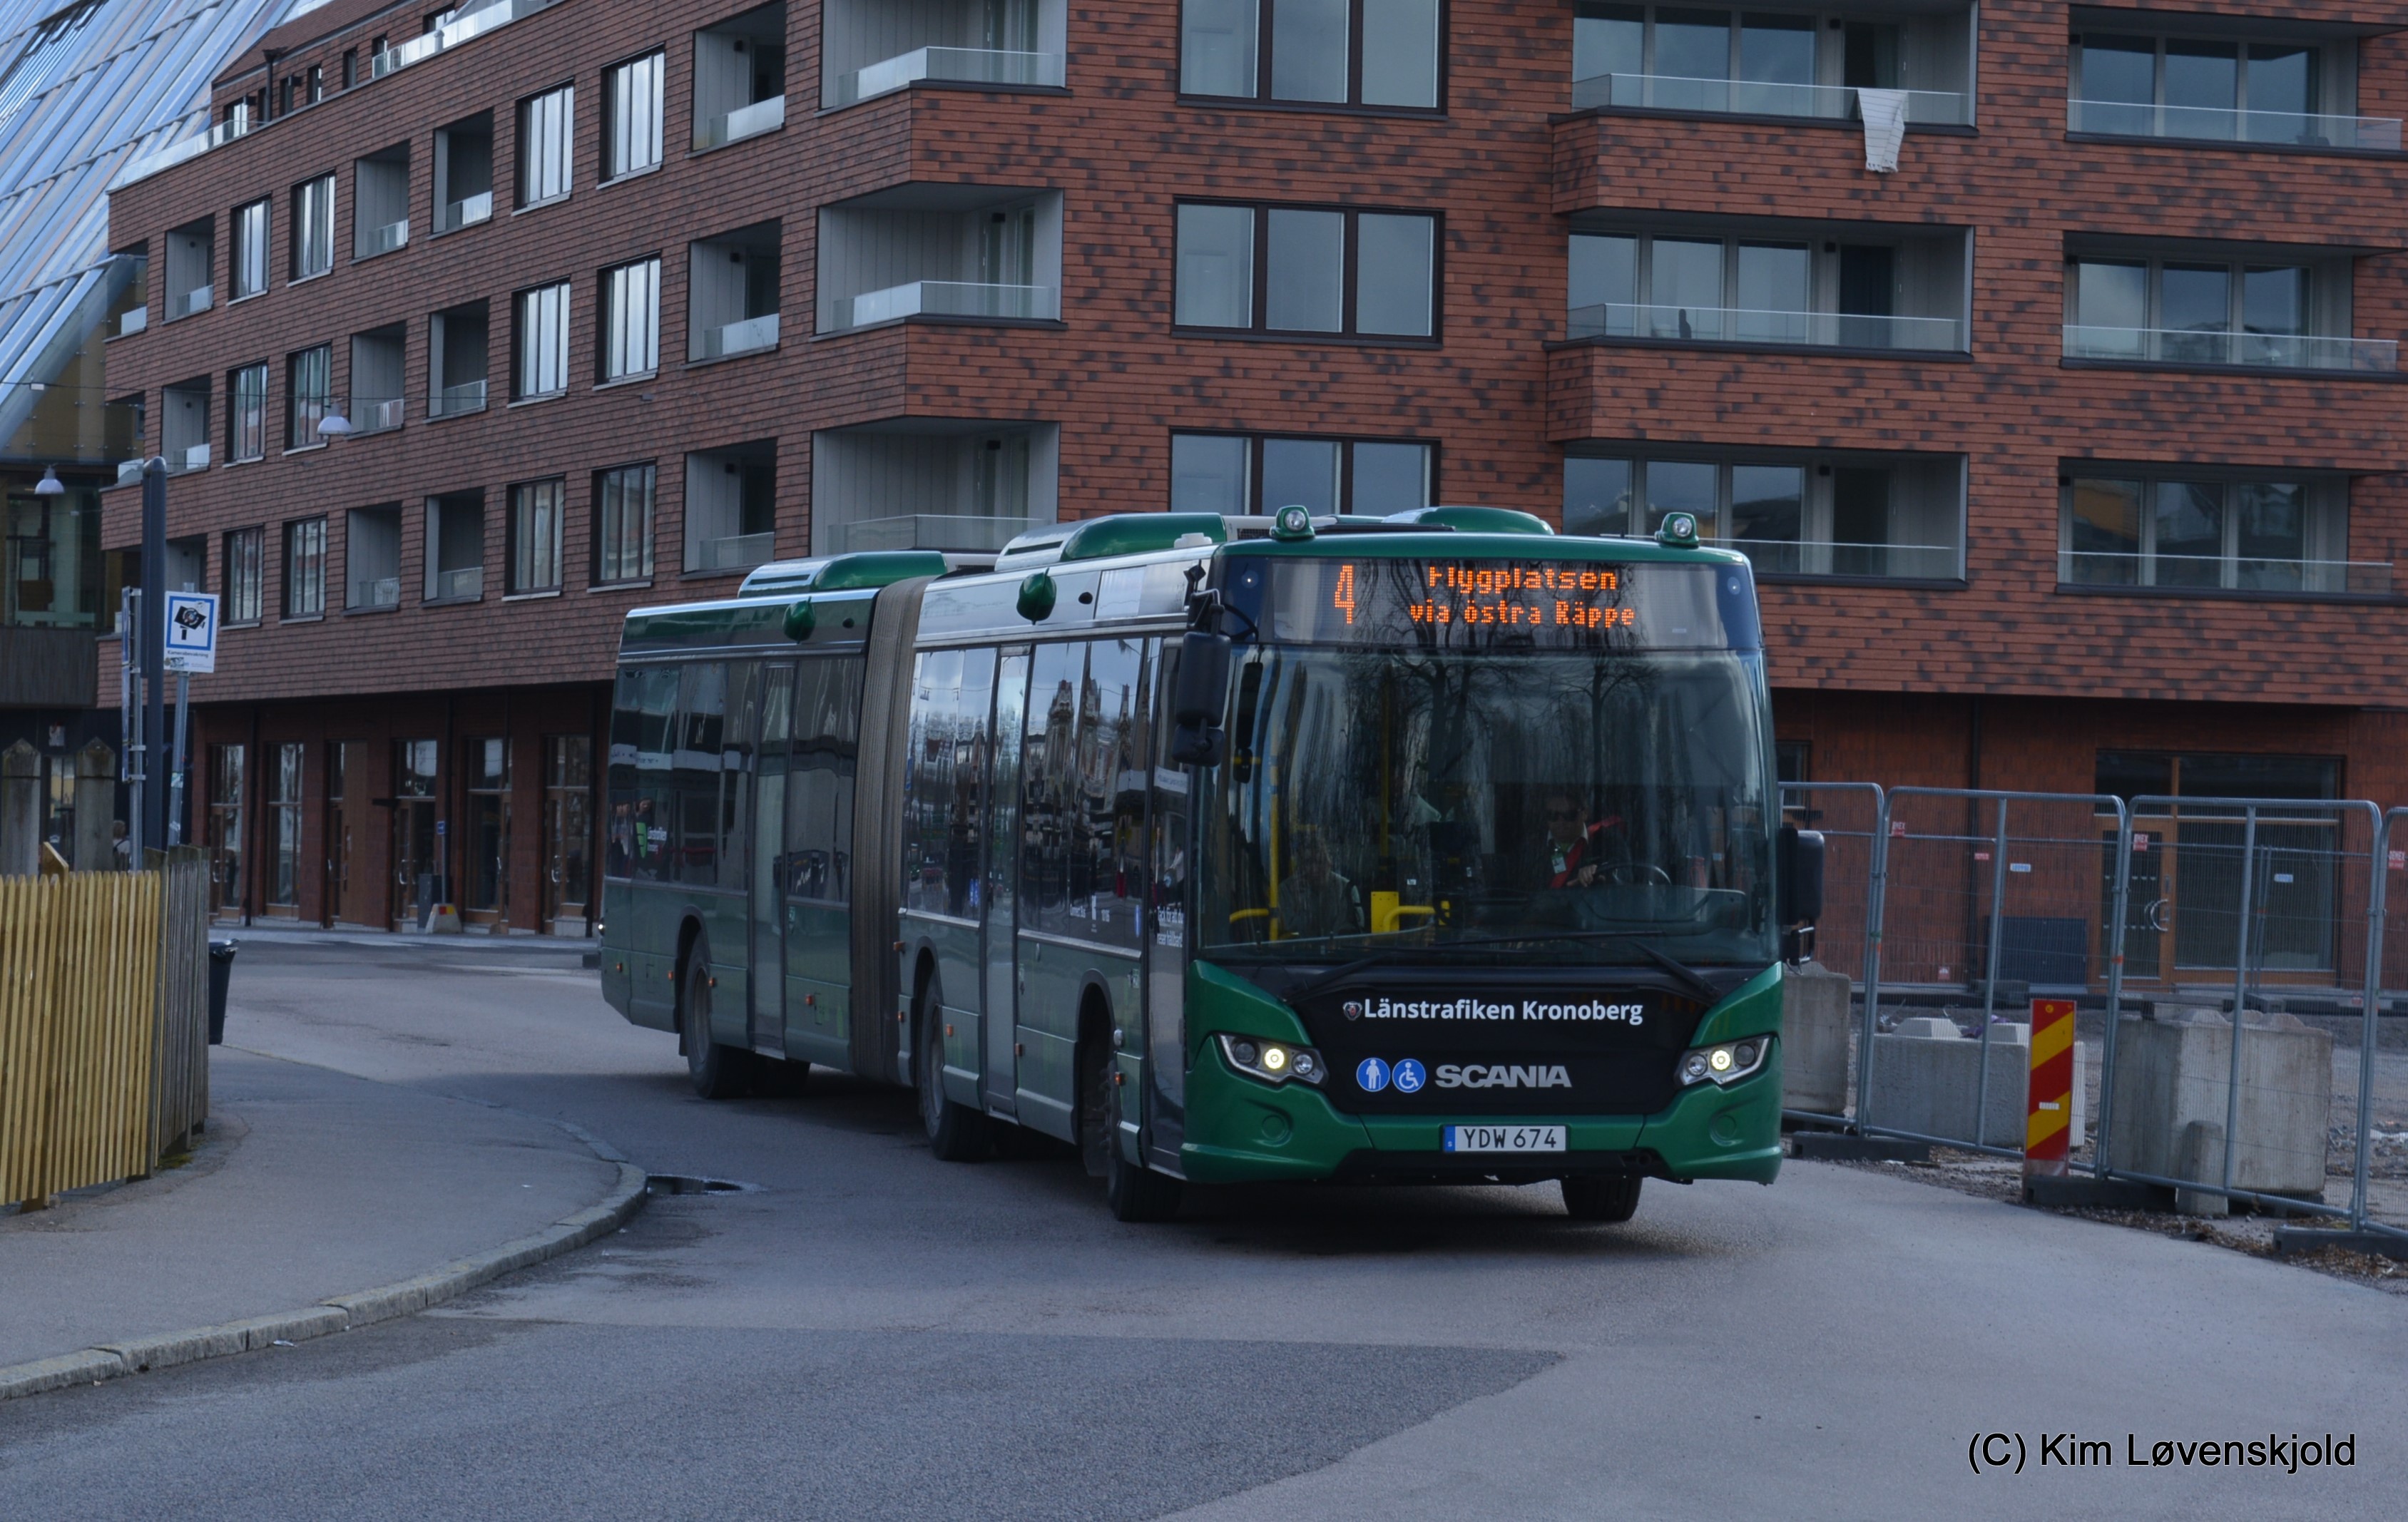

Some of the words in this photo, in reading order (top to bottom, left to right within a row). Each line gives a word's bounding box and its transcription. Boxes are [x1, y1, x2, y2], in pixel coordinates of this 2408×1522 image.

[1429, 566, 1616, 593] Flygplatsen
[1335, 565, 1354, 623] 4
[1409, 599, 1450, 623] via
[1464, 600, 1541, 624] östra
[1555, 601, 1636, 628] Räppe
[1364, 999, 1514, 1020] Länstrafiken
[1523, 1001, 1643, 1025] Kronoberg
[1435, 1065, 1572, 1088] SCANIA
[1464, 1128, 1505, 1149] YDW
[1514, 1128, 1556, 1149] 674
